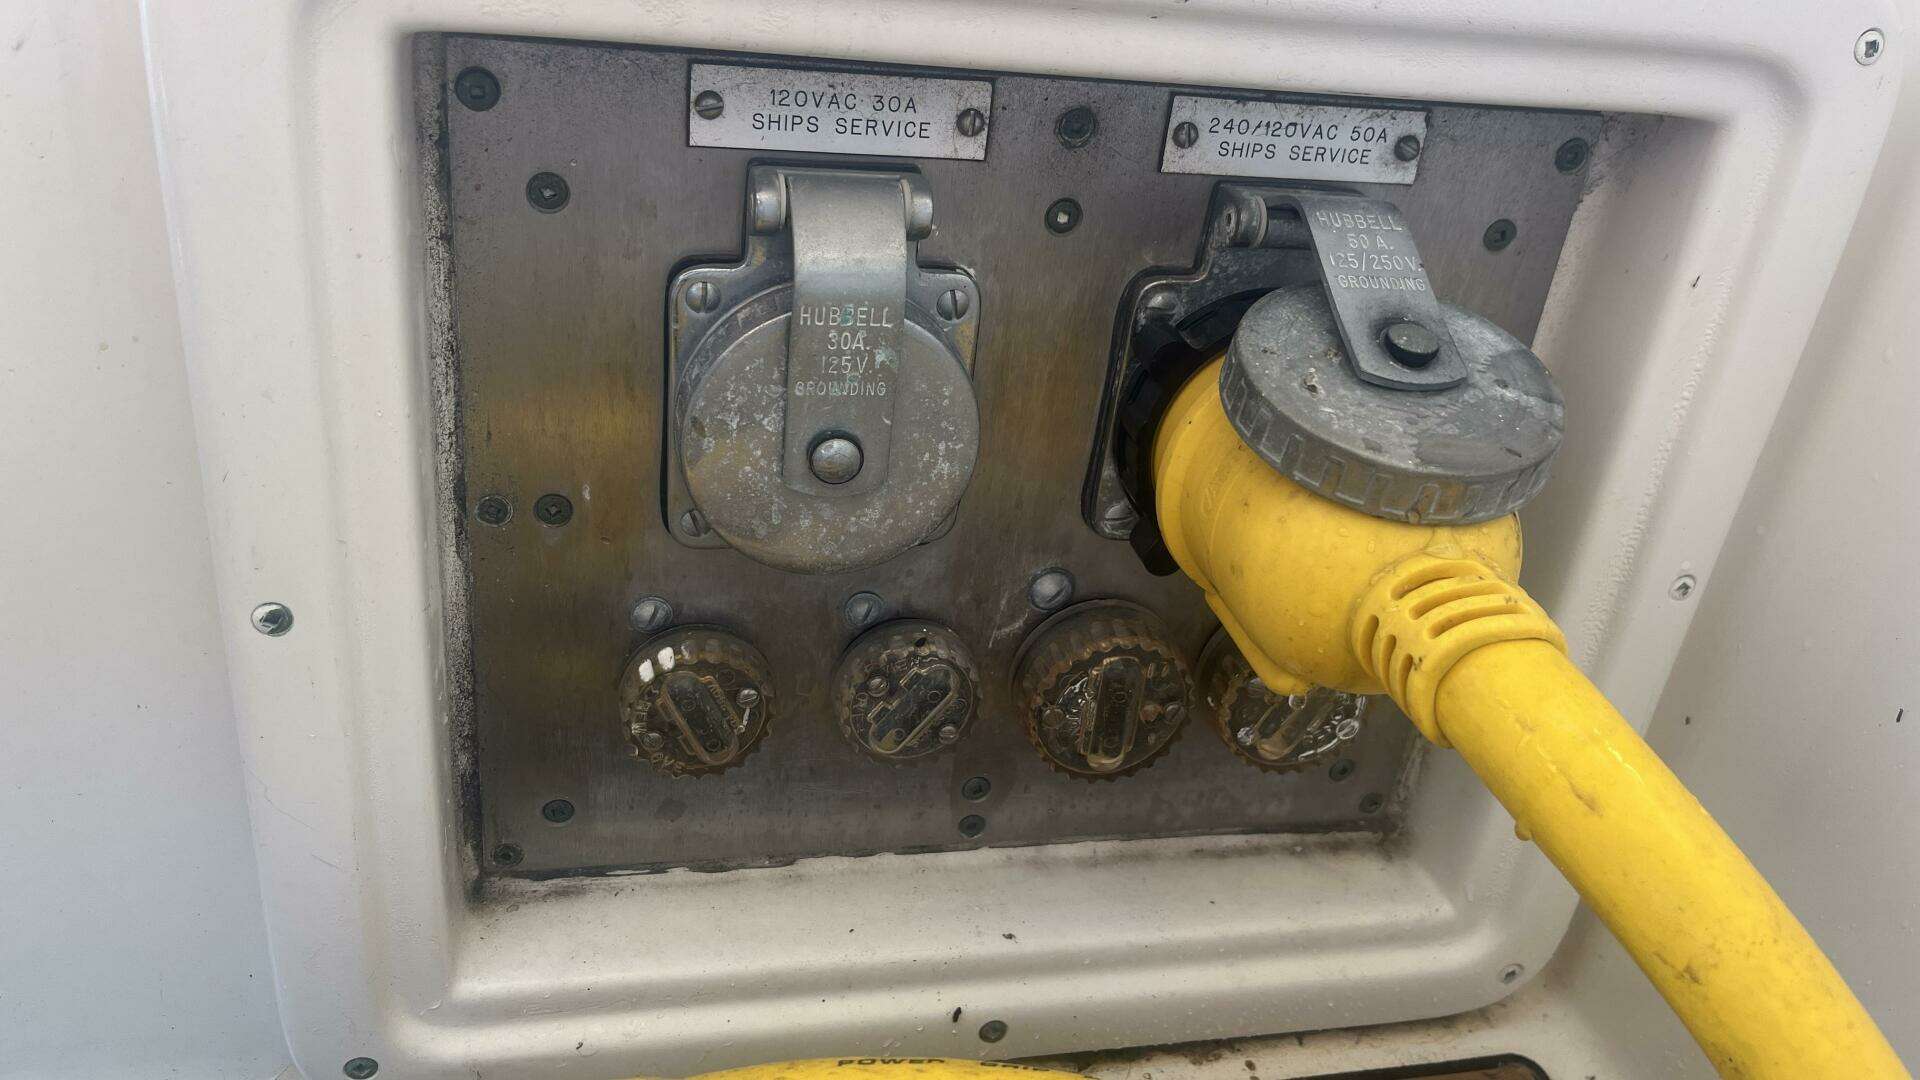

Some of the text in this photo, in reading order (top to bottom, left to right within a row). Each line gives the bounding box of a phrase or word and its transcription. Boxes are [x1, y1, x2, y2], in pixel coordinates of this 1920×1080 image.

[769, 88, 918, 113] 120VAC 30A
[751, 112, 931, 139] SHIPS SERVICE
[1208, 117, 1388, 144] 240/120VAC 50A
[1217, 141, 1372, 165] SHIPS SERVICE
[1315, 209, 1403, 232] HUBBELL
[1335, 273, 1427, 292] GROUNDING
[799, 303, 895, 328] HUBBELL
[827, 331, 872, 351] 30A.
[794, 380, 889, 397] GROUNDING
[836, 1057, 946, 1068] POWER
